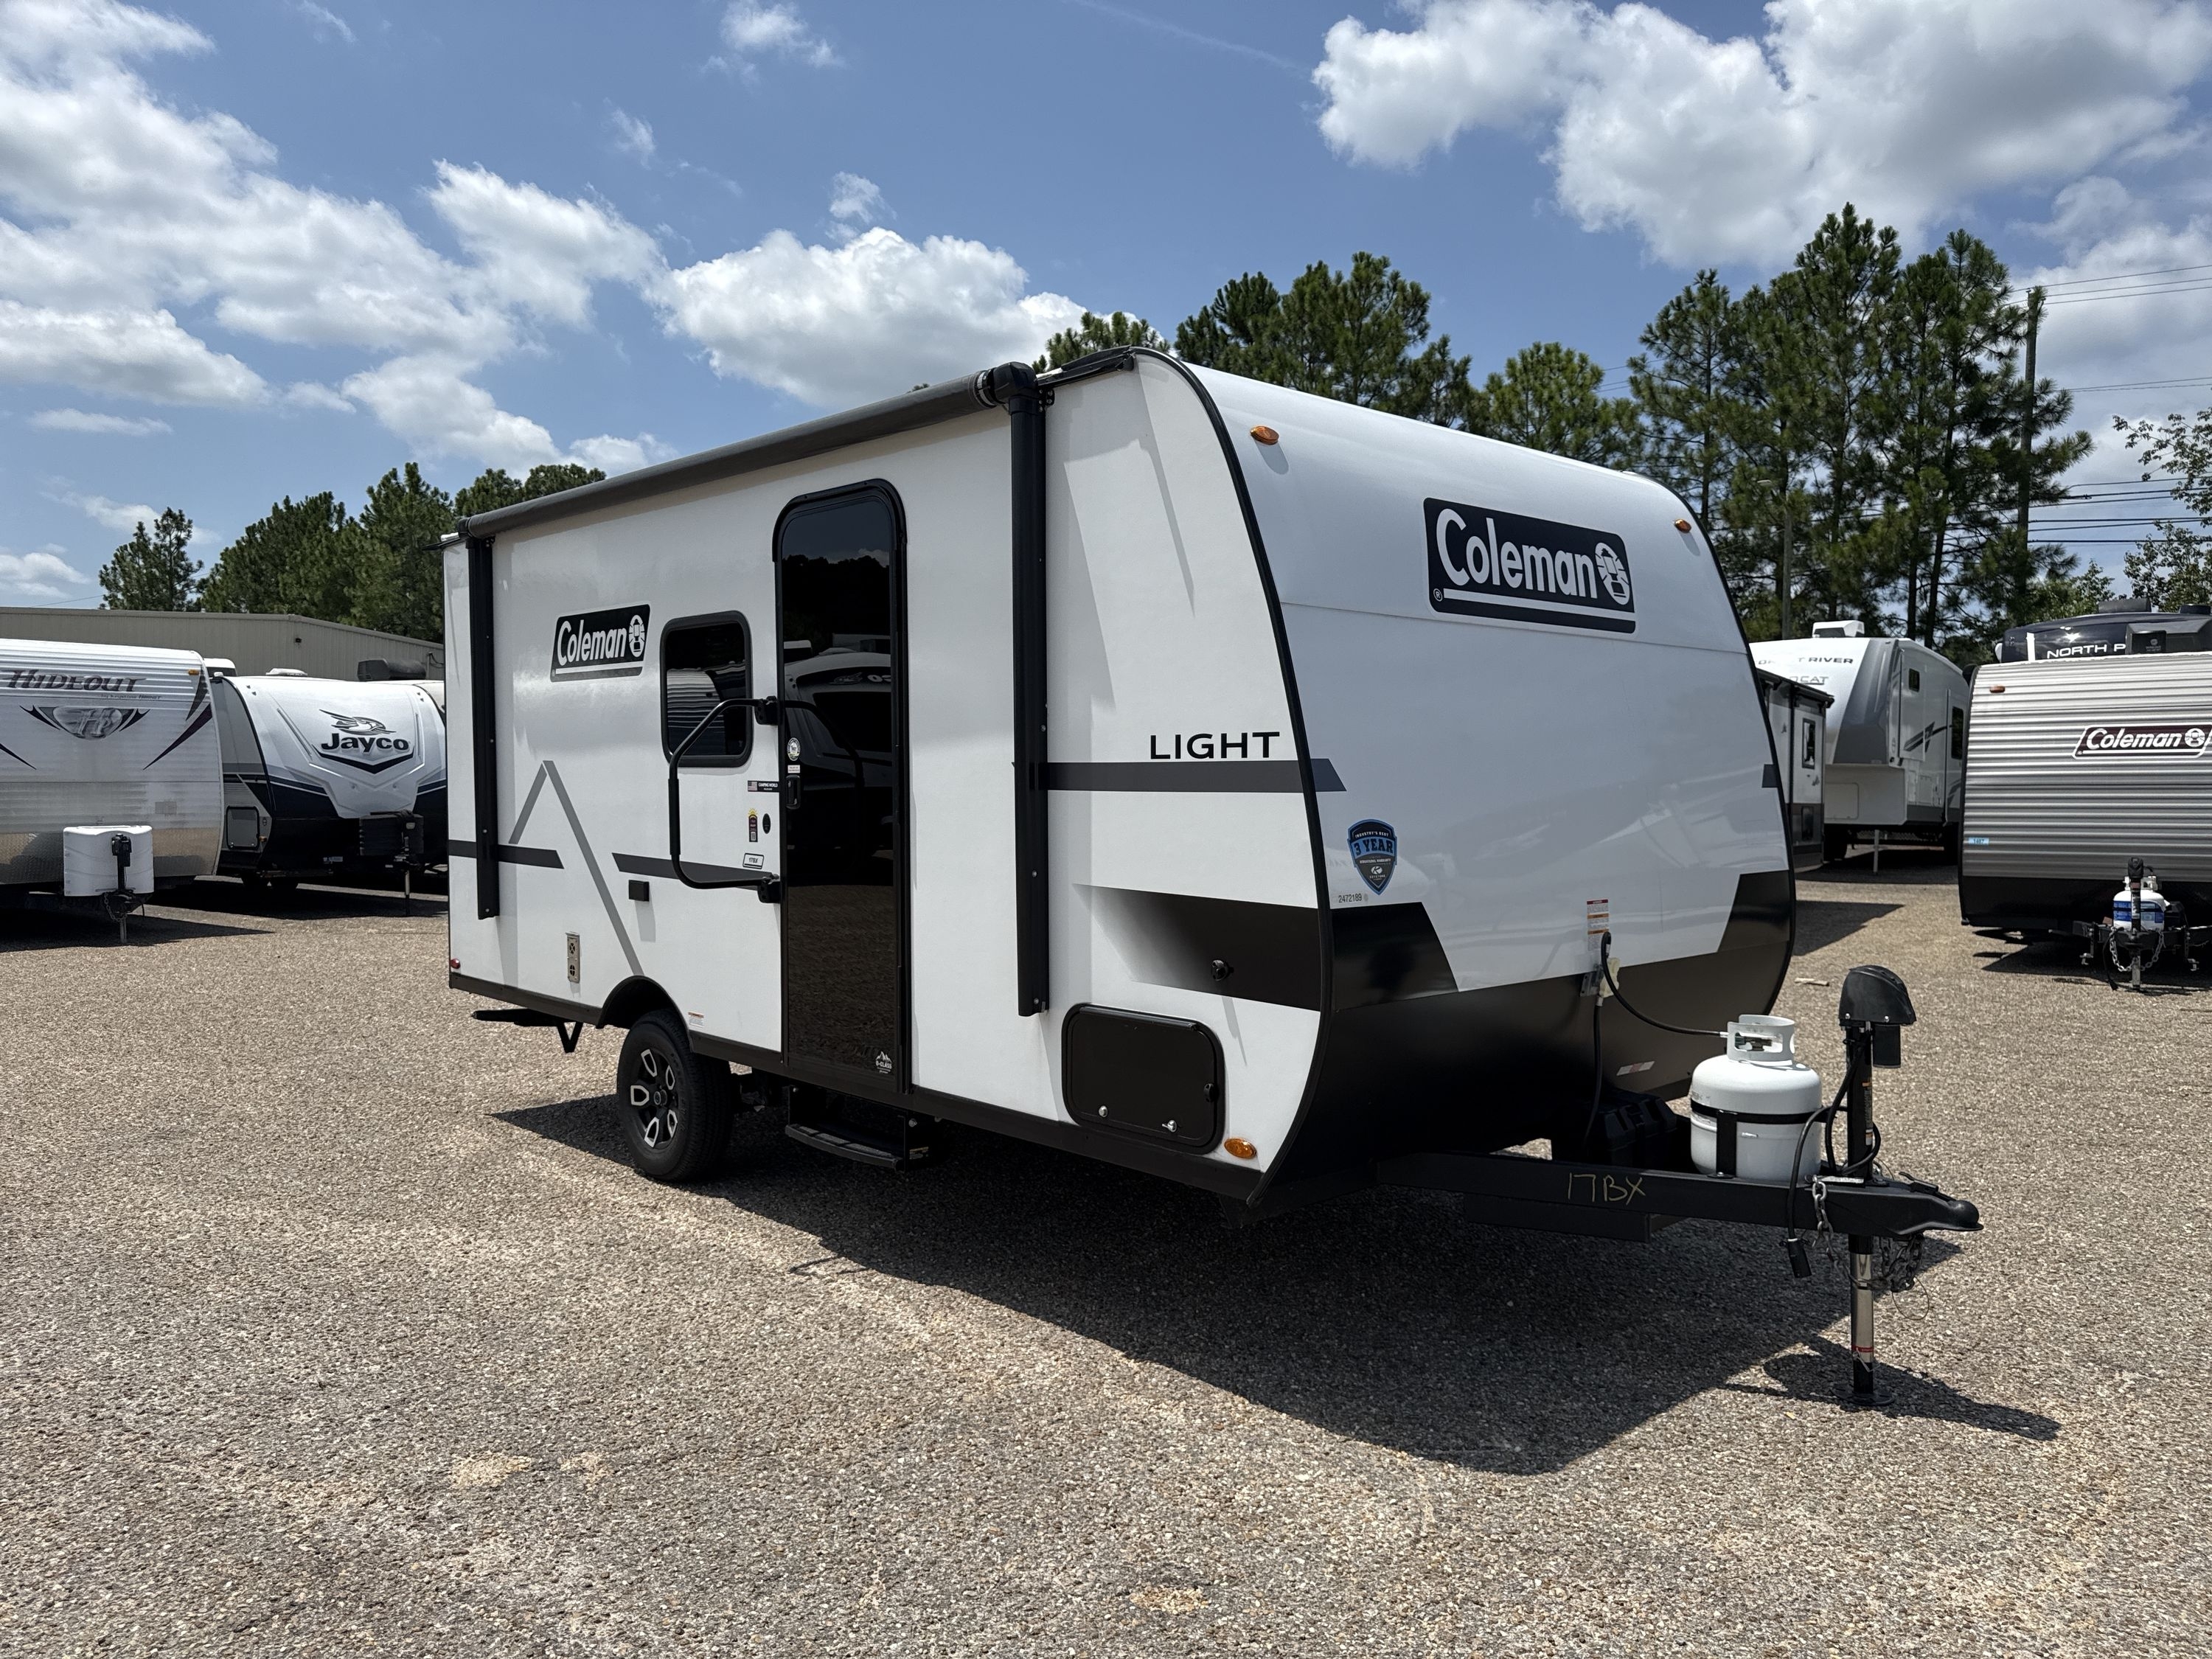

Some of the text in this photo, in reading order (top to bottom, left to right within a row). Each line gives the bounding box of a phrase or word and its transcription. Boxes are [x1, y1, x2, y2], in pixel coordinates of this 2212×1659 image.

[1436, 508, 1598, 599] Coleman
[557, 620, 627, 666] Coleman
[2047, 643, 2126, 658] NORTH P
[321, 733, 409, 752] Jayco
[1150, 731, 1280, 759] LIGHT
[2086, 728, 2183, 750] Coleman
[1354, 831, 1378, 839] INDUSTRY'S
[1354, 838, 1394, 856] 3 YEAR
[1338, 893, 1363, 903] 2472189
[1568, 1172, 1646, 1206] 17BX
